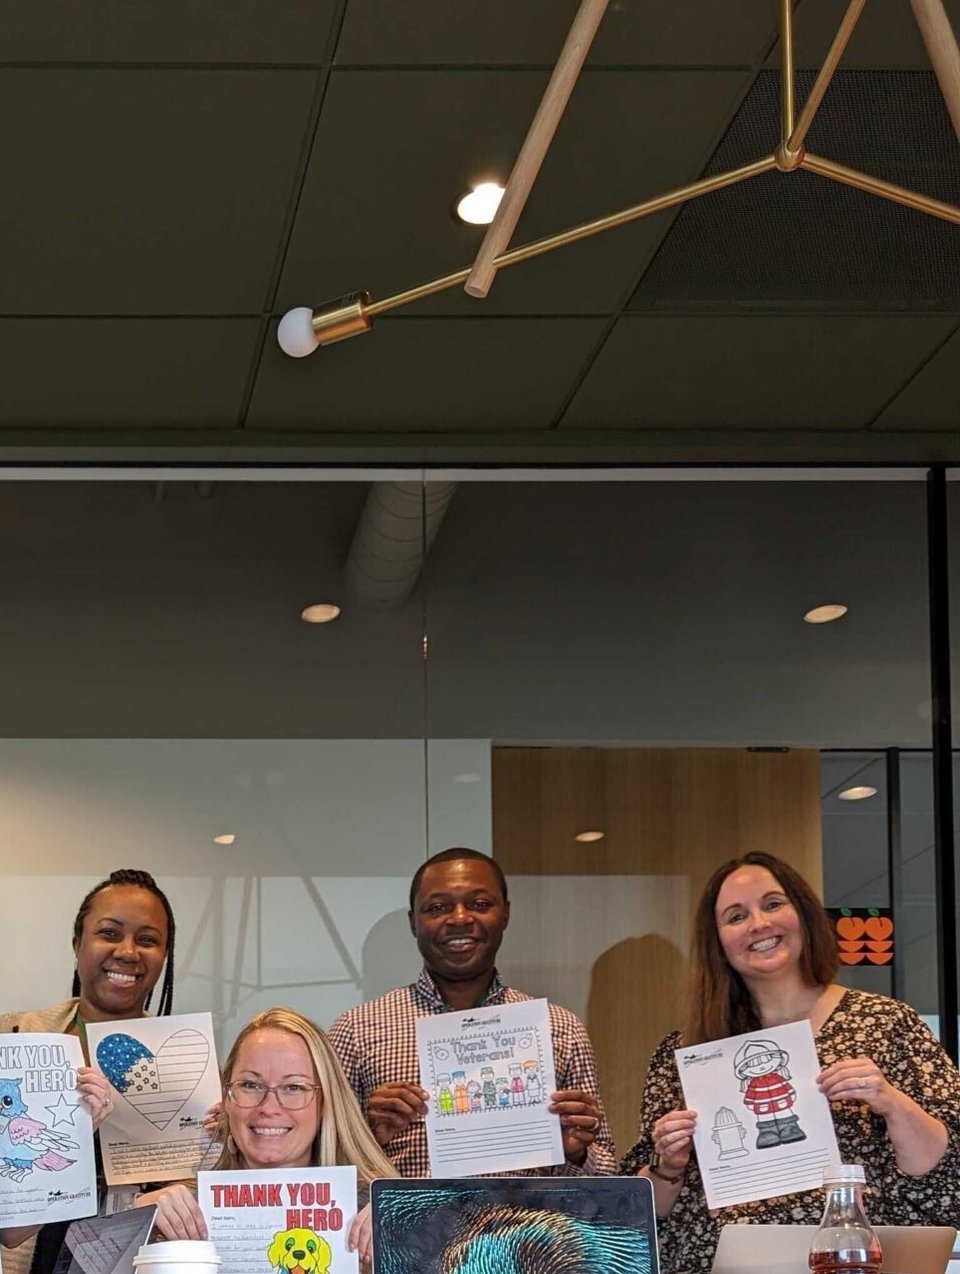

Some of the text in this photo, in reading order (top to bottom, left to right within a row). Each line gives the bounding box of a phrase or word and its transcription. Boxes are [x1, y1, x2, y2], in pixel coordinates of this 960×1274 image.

[451, 1035, 516, 1054] Thank You
[456, 1046, 515, 1065] Veterans!
[24, 1045, 70, 1068] YOU,
[25, 1068, 78, 1093] HERO
[210, 1182, 337, 1208] THANK YOU,
[286, 1208, 343, 1231] HERO
